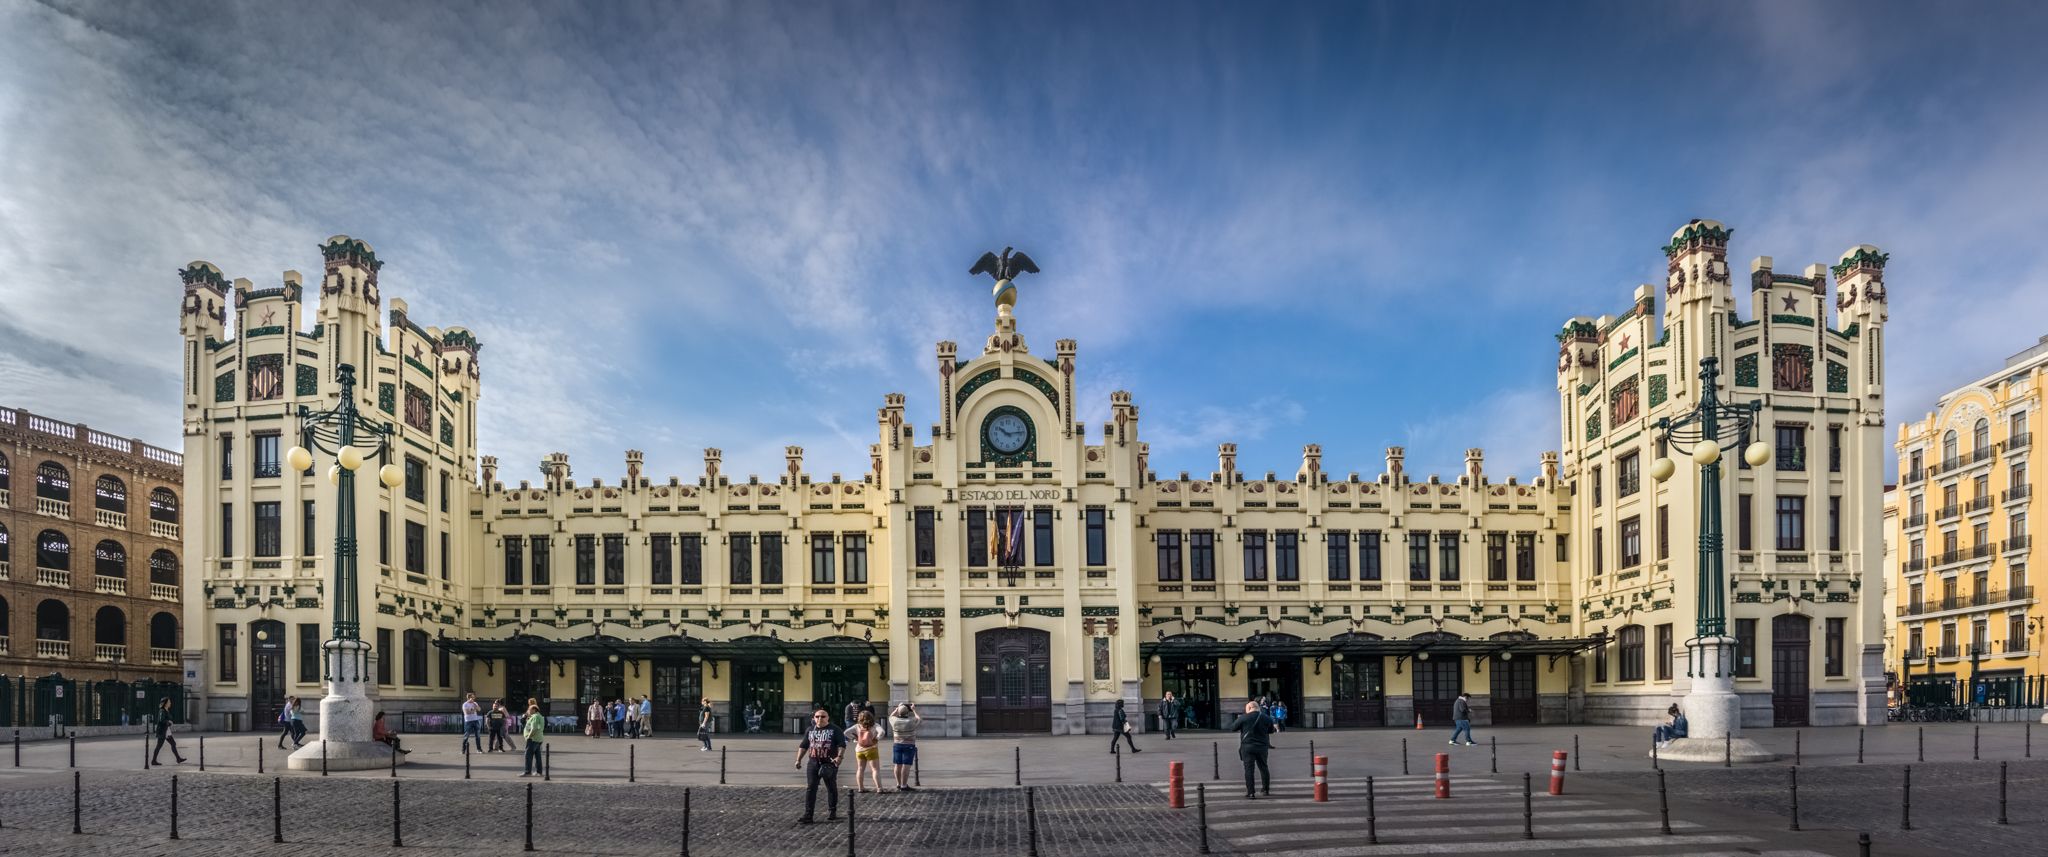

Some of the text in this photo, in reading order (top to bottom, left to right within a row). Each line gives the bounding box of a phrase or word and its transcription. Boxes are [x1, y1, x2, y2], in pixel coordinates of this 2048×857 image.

[960, 488, 1060, 500] ESTACIÓ DEL NORD
